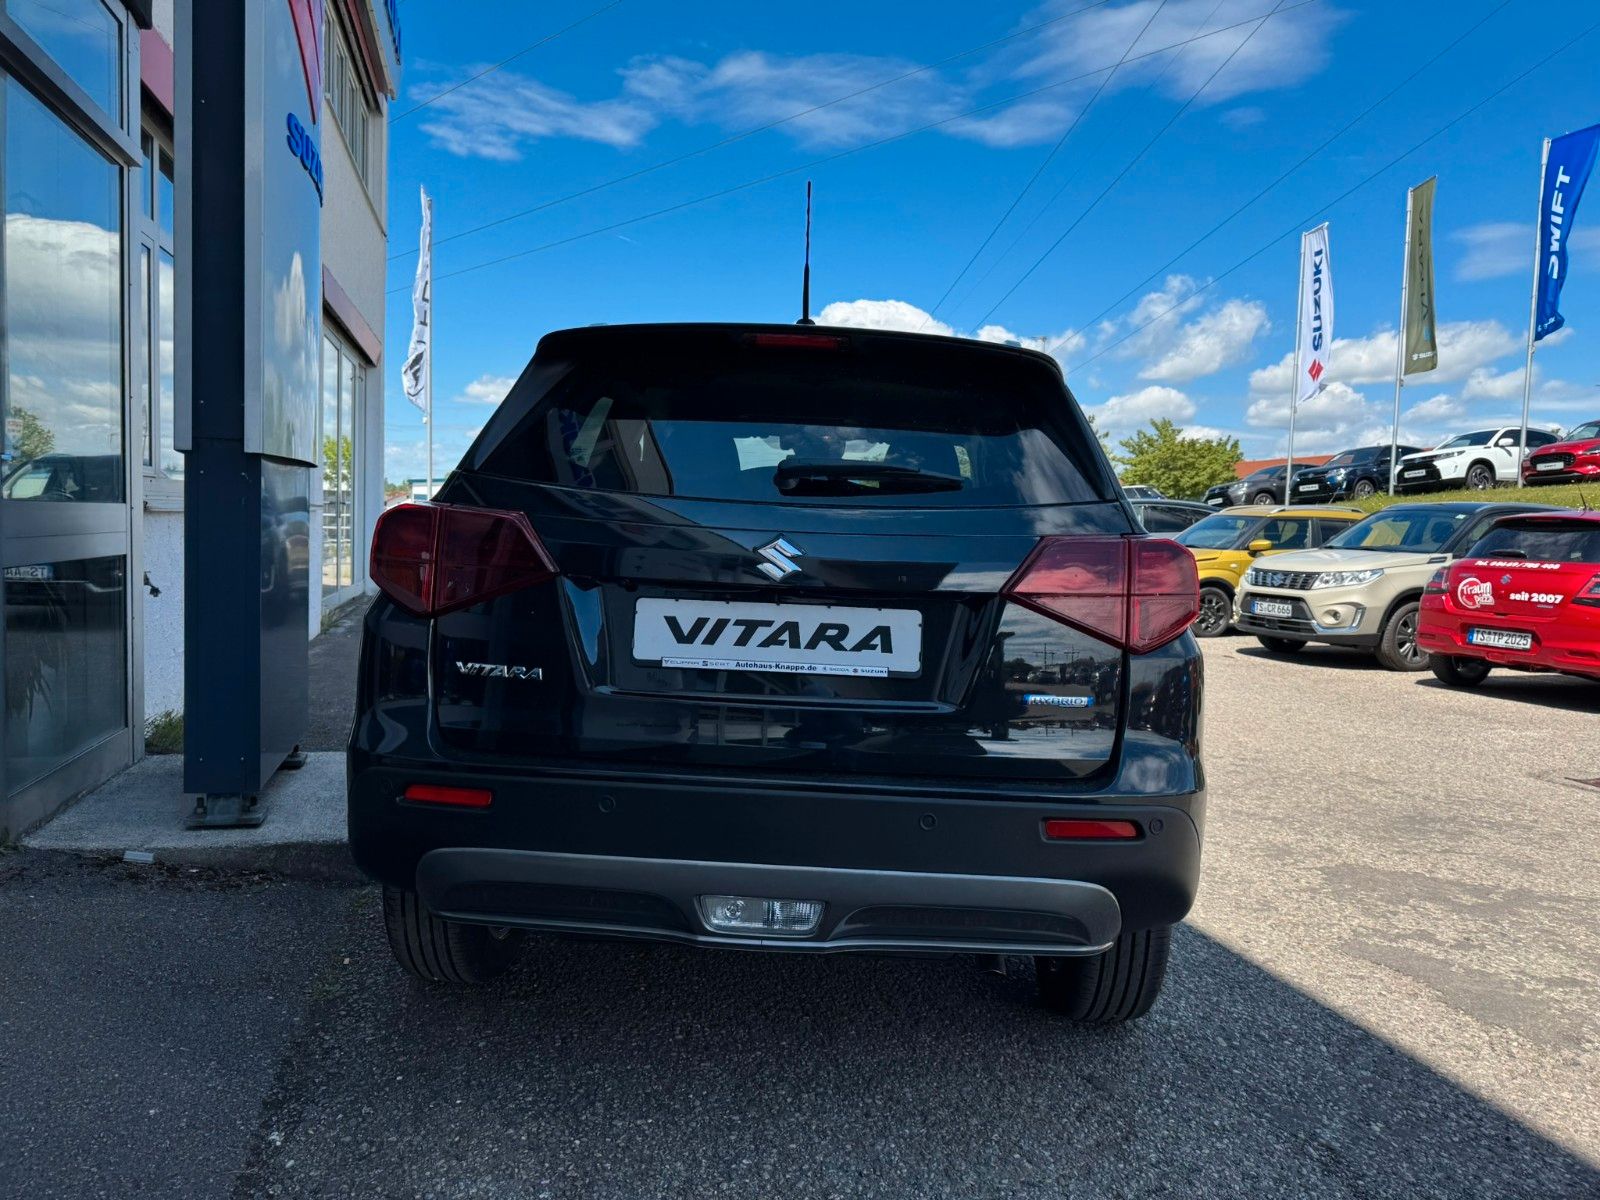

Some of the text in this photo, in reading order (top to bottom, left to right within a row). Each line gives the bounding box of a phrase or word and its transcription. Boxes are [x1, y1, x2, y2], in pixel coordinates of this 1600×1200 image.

[1312, 248, 1323, 352] SUZUKI
[1509, 591, 1565, 604] seit 2007
[1256, 602, 1264, 612] TS
[663, 615, 893, 655] VITARA
[1476, 630, 1486, 641] TS
[1504, 633, 1530, 646] 2025
[455, 661, 543, 681] VITARA
[735, 661, 817, 672] Autohaus-Knappe.de
[860, 667, 888, 675] SUZUKI
[1026, 694, 1090, 707] HYBRID
